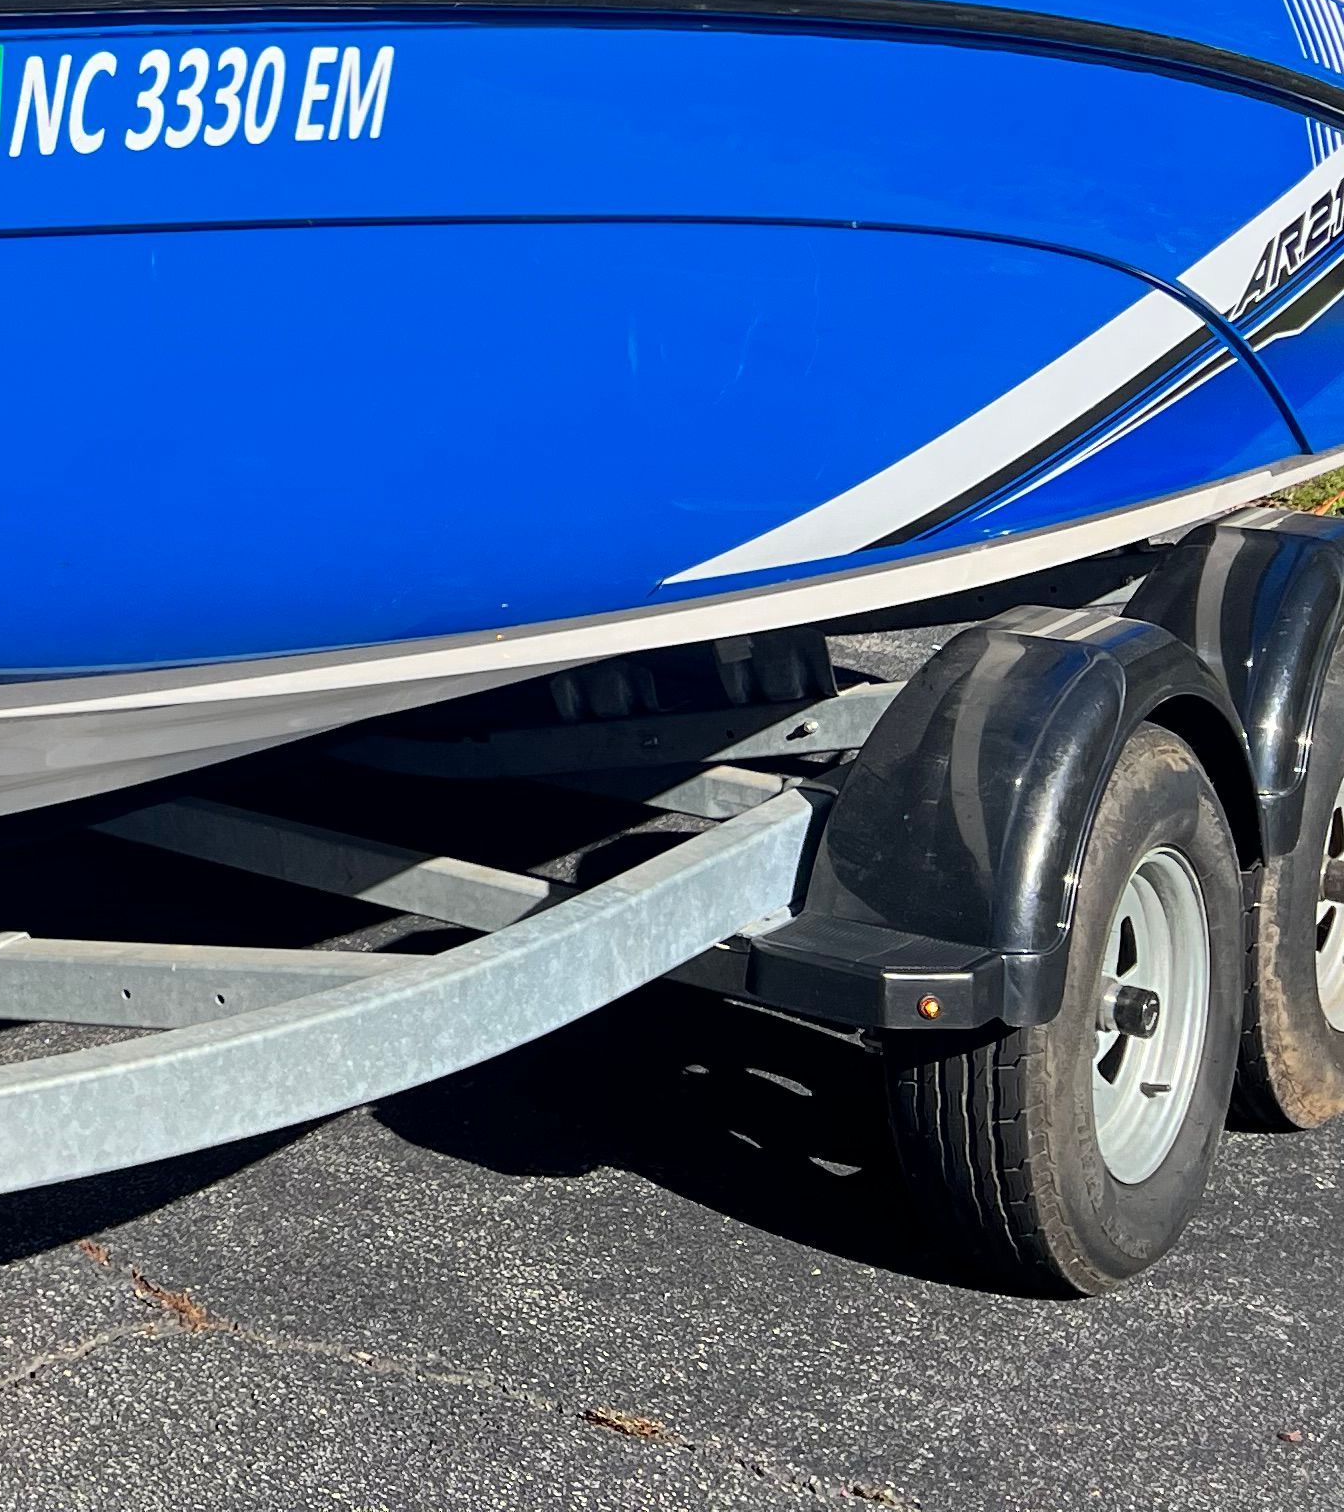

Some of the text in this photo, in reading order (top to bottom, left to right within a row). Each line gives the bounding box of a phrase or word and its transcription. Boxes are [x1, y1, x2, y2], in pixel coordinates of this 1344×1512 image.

[9, 45, 394, 157] NC 3330 EM
